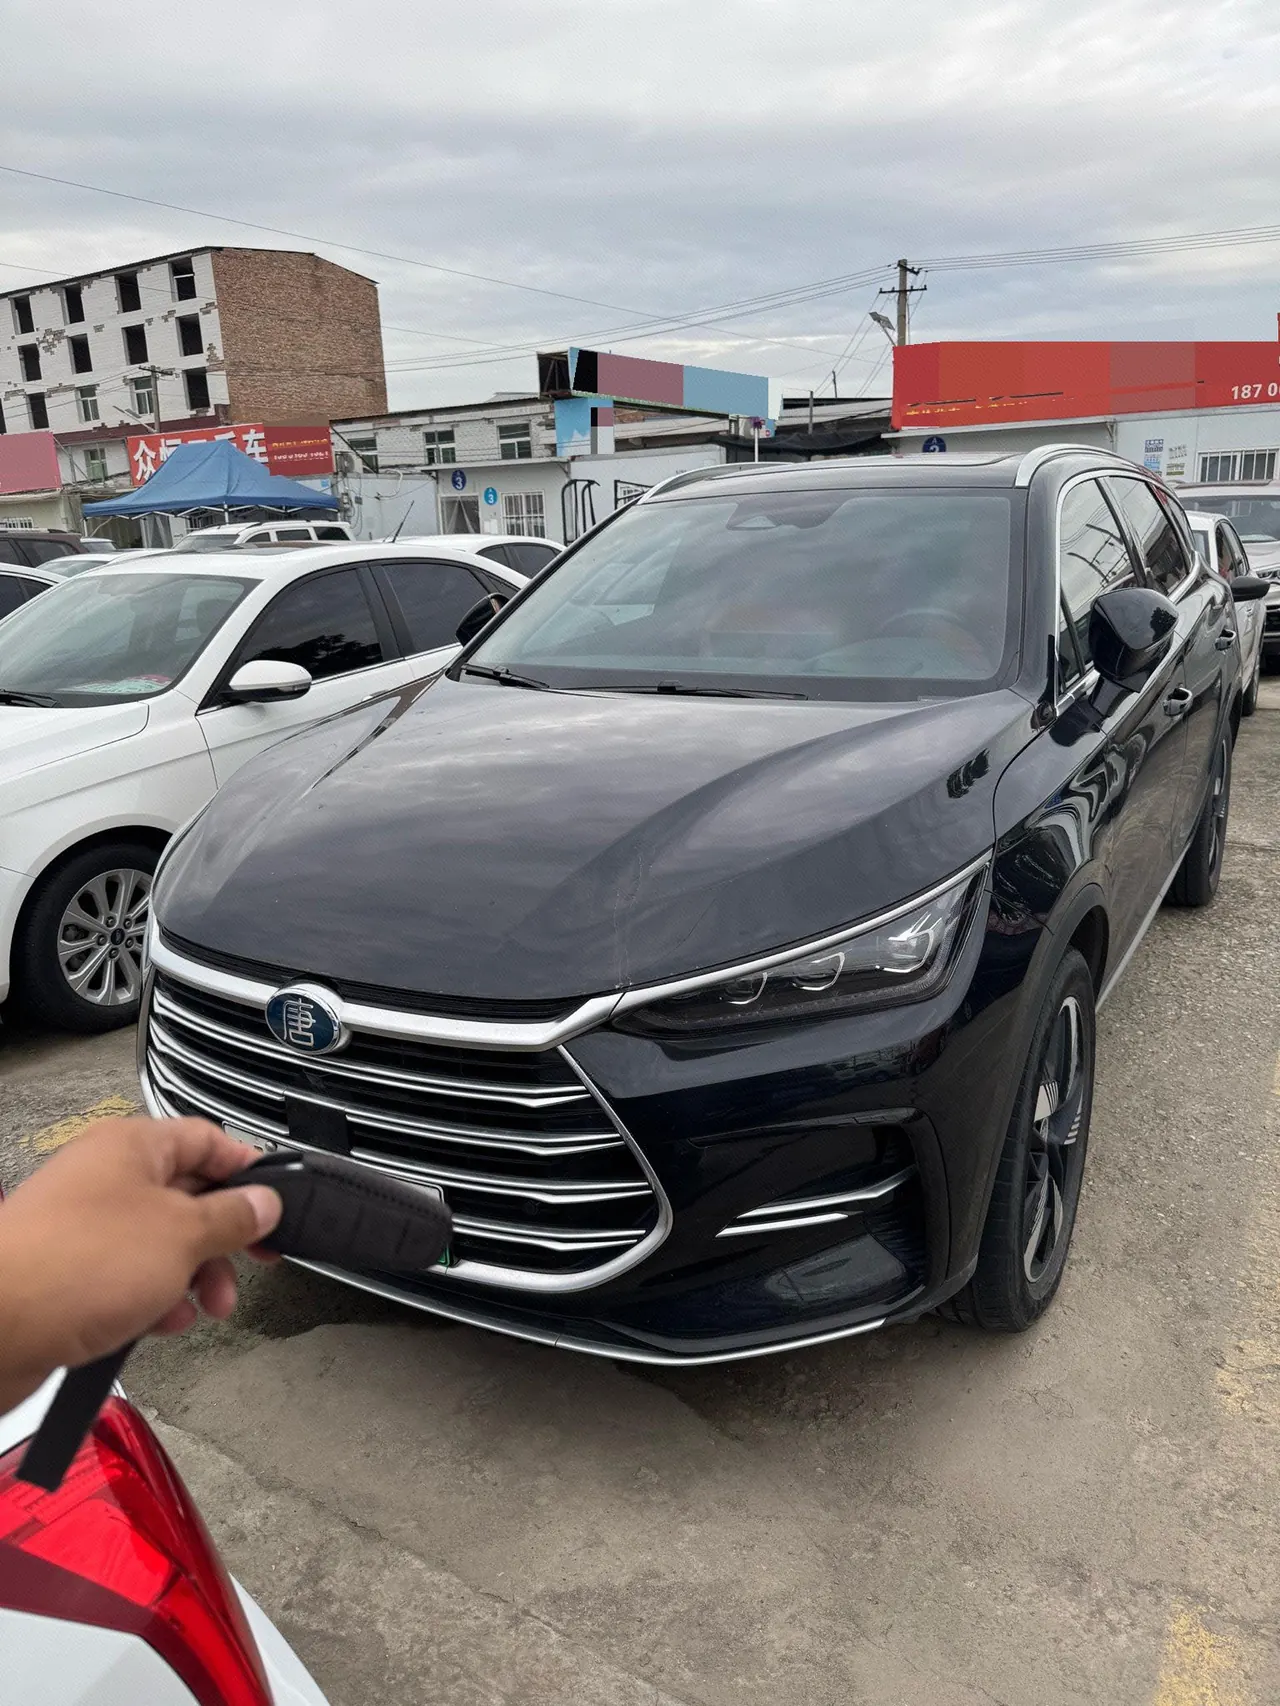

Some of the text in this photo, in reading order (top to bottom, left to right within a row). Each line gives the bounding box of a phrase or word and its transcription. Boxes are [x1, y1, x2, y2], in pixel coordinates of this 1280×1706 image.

[1231, 382, 1280, 400] 187 0
[455, 476, 463, 489] 3
[488, 494, 494, 504] 3
[283, 997, 317, 1047] 唐
